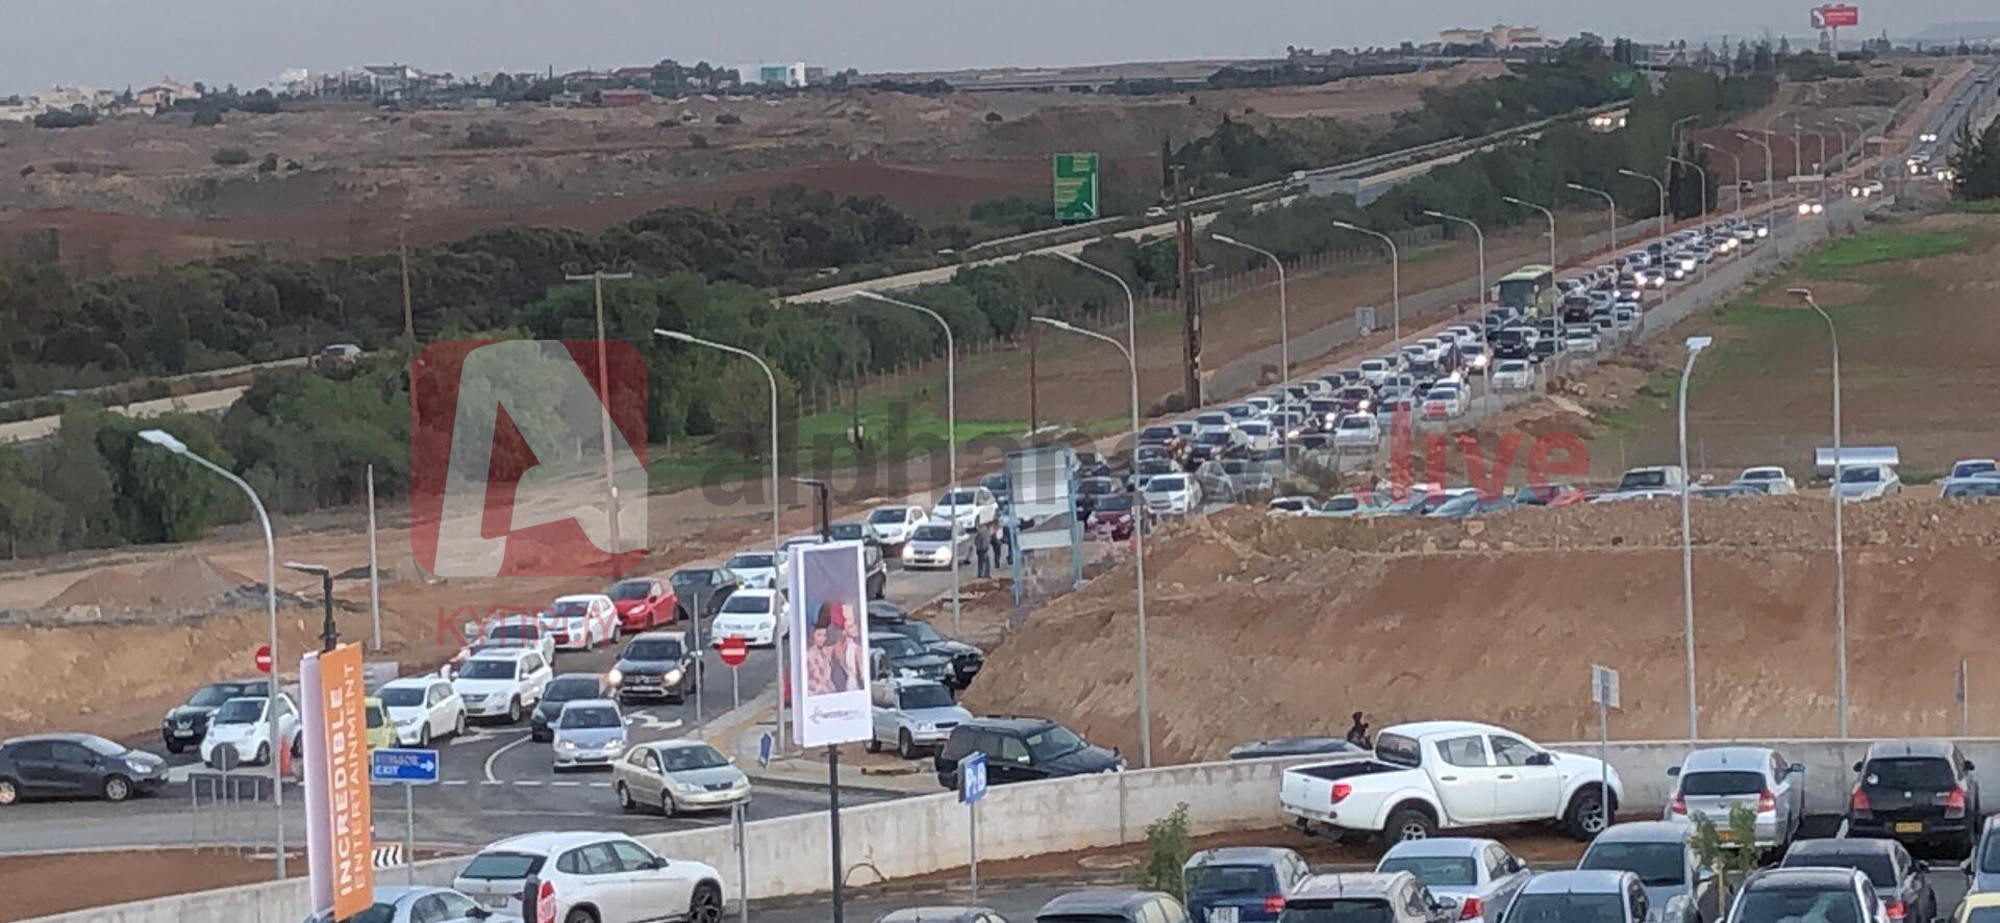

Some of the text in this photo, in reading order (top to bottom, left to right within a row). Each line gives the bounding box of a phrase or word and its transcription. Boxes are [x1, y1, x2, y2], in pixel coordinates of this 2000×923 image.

[331, 687, 353, 896] INCREDIBLE
[343, 664, 366, 889] ENTERTAINMENT
[375, 764, 400, 775] EXIT
